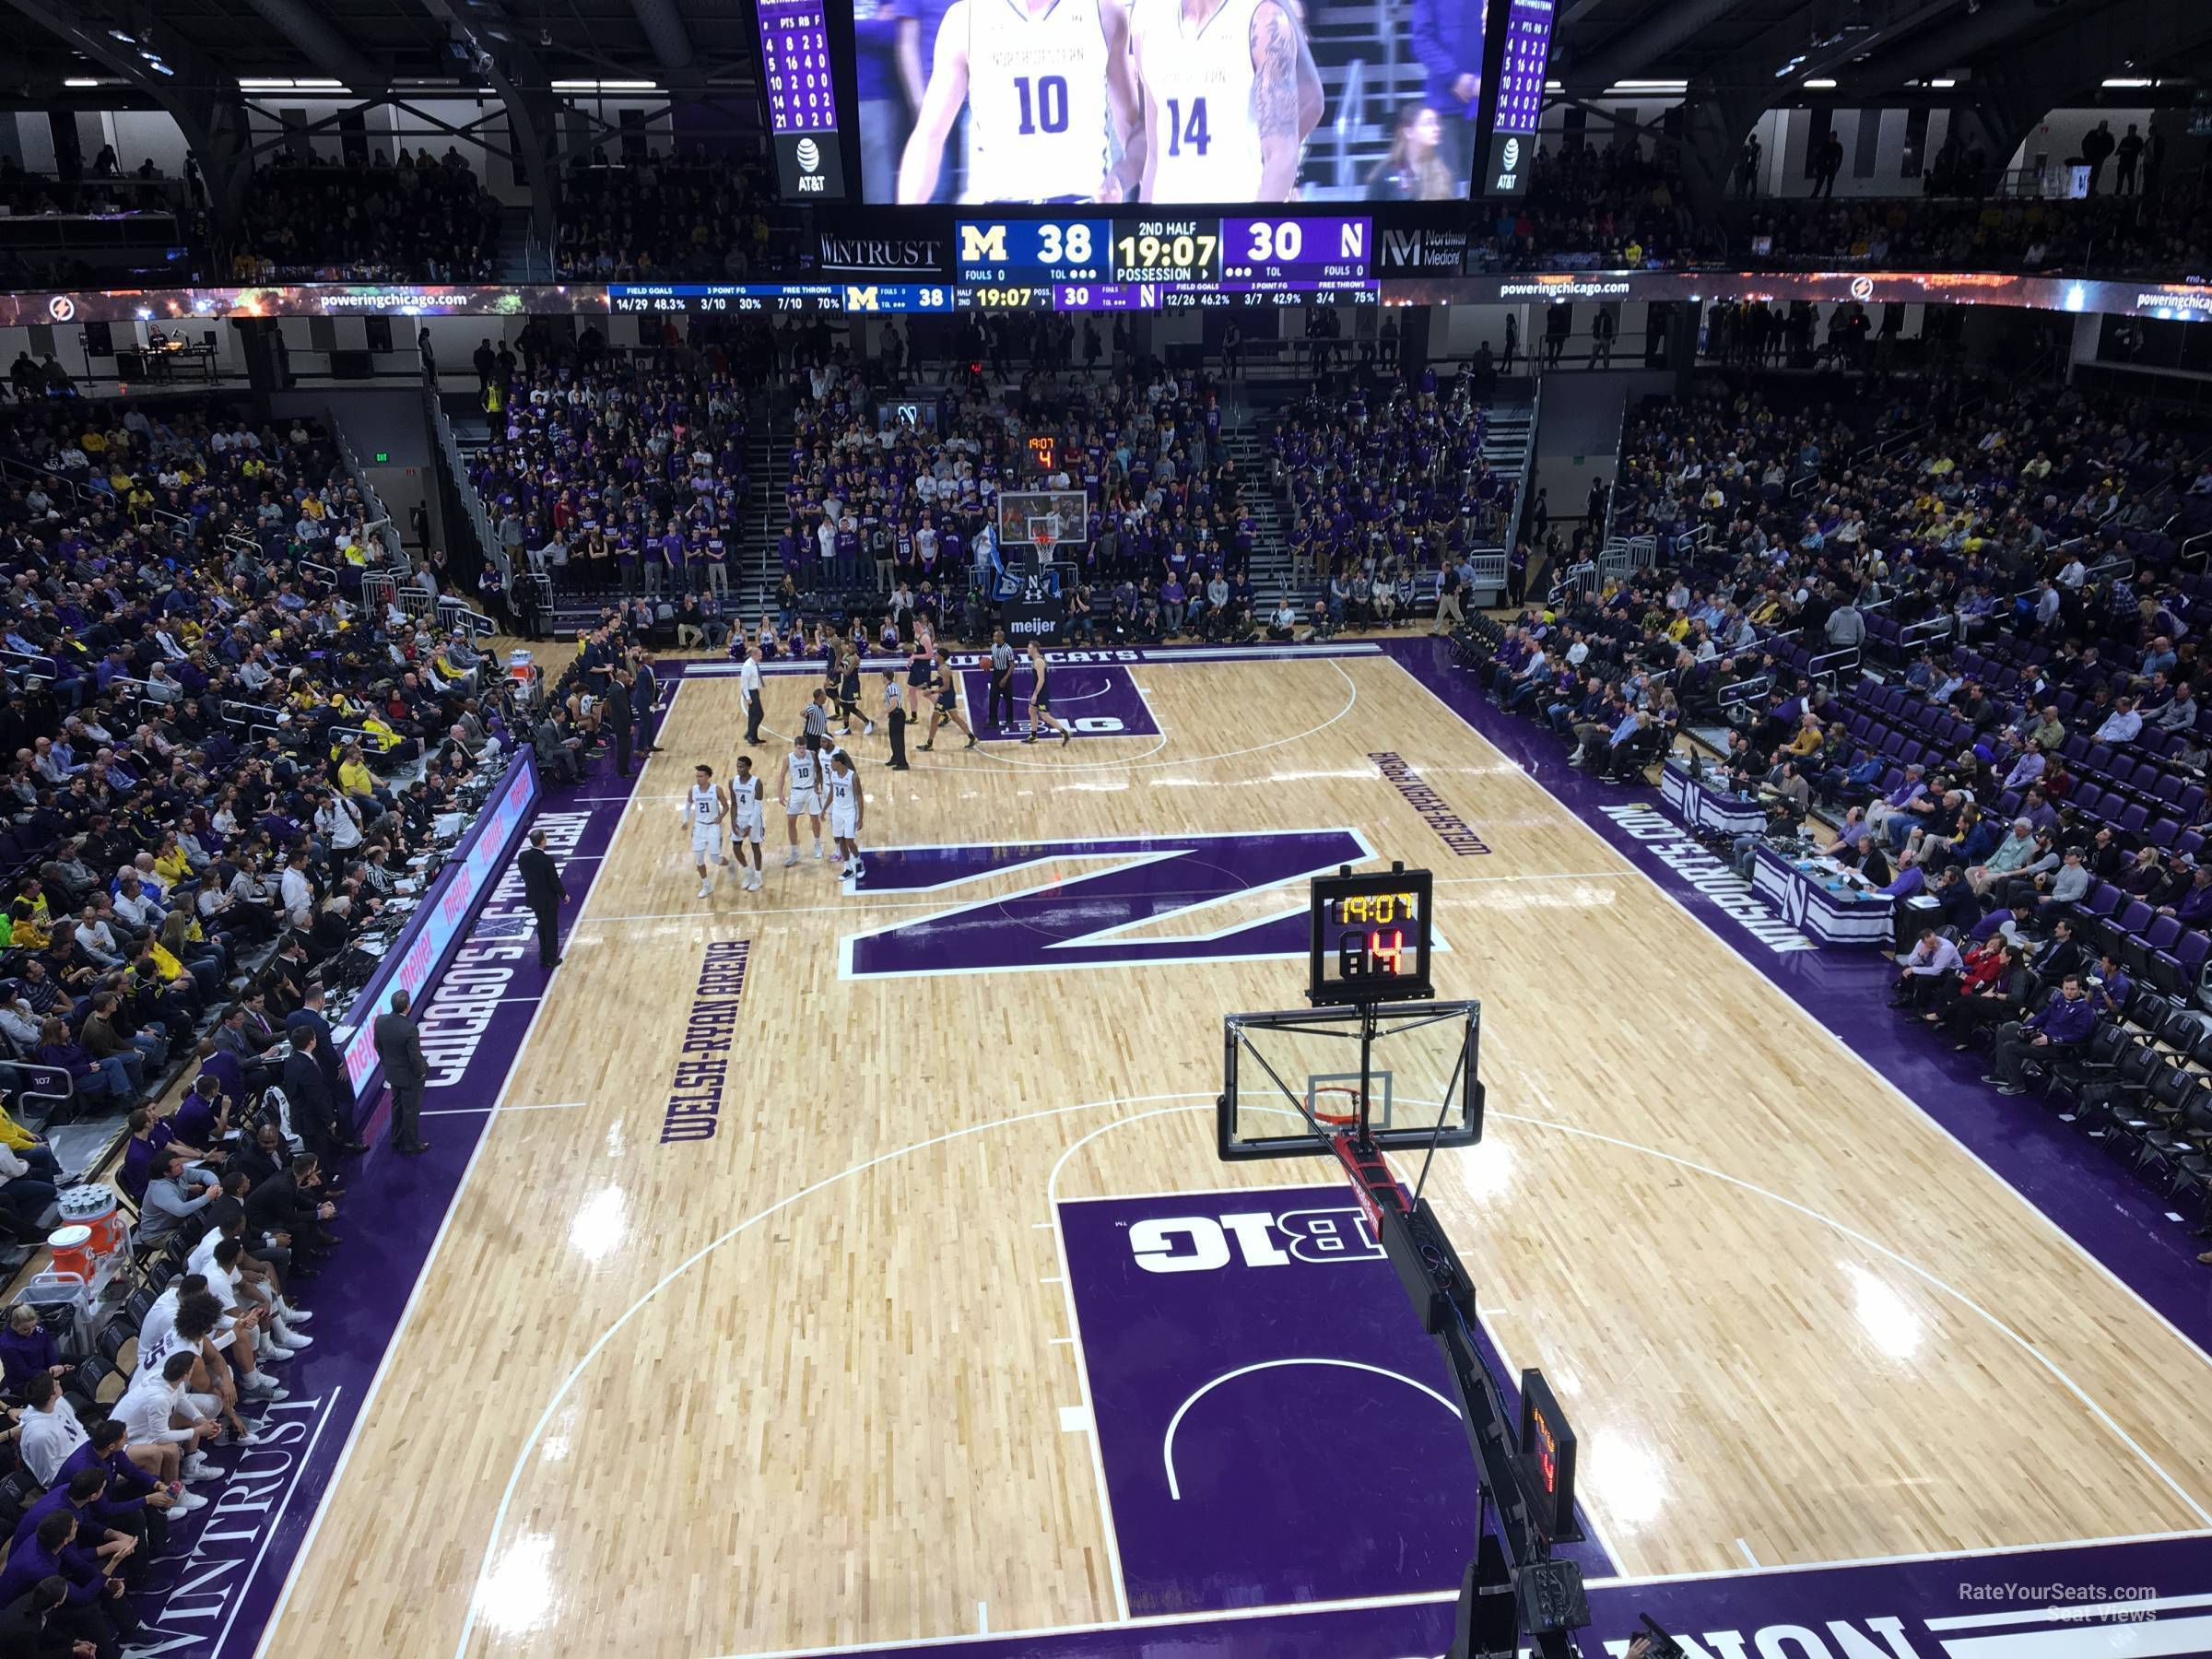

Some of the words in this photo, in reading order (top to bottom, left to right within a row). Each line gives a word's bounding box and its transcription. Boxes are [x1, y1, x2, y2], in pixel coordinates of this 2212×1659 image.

[780, 18, 794, 29] PTS
[798, 16, 809, 27] RB
[815, 15, 819, 26] F
[766, 38, 773, 53] 4
[786, 36, 794, 51] 8
[802, 35, 809, 50] 2
[816, 34, 822, 49] 3
[1508, 38, 1513, 53] 4
[1521, 40, 1527, 54] 8
[1532, 41, 1537, 55] 2
[1540, 42, 1545, 57] 3
[768, 57, 775, 72] 5
[786, 55, 798, 70] 16
[805, 54, 812, 69] 4
[818, 53, 825, 68] 0
[1505, 56, 1511, 71] 5
[1517, 58, 1525, 73] 16
[1529, 60, 1534, 74] 4
[1537, 61, 1543, 75] 0
[771, 76, 782, 90] 10
[791, 75, 798, 89] 2
[806, 74, 814, 88] 0
[821, 73, 828, 88] 0
[1502, 76, 1511, 89] 10
[1515, 76, 1521, 91] 2
[1526, 78, 1532, 92] 0
[1535, 79, 1540, 93] 0
[773, 95, 784, 109] 14
[793, 94, 800, 108] 4
[809, 93, 817, 107] 0
[823, 92, 830, 107] 2
[1014, 76, 1068, 135] 10
[1500, 94, 1508, 108] 14
[1513, 95, 1518, 109] 4
[1524, 96, 1529, 110] 0
[1532, 97, 1537, 111] 2
[775, 113, 786, 128] 21
[795, 112, 803, 127] 0
[811, 112, 818, 126] 2
[826, 112, 832, 125] 0
[1167, 97, 1211, 157] 14
[1497, 112, 1505, 126] 21
[1511, 113, 1516, 127] 0
[1521, 114, 1526, 128] 2
[1530, 114, 1535, 128] 0
[798, 175, 825, 192] AT&T
[1497, 174, 1516, 190] AT&T
[1139, 222, 1162, 236] 2ND
[1167, 222, 1196, 236] HALF
[961, 225, 1006, 261] M
[1037, 224, 1092, 263] 38
[1247, 222, 1301, 261] 30
[1341, 223, 1362, 257] N
[1118, 236, 1216, 266] 19:07
[966, 270, 992, 280] FOULS
[998, 270, 1005, 280] 0
[1051, 270, 1066, 279] TOL
[1117, 268, 1191, 281] POSSESSION
[1266, 267, 1281, 276] TOL
[1324, 265, 1350, 276] FOULS
[1357, 265, 1363, 276] 0
[919, 288, 944, 306] 38
[976, 288, 1030, 306] 19:07
[1065, 288, 1088, 305] 30
[1140, 285, 1154, 307] N
[1316, 291, 1334, 304] 3/4
[1355, 292, 1374, 303] 75%
[1501, 281, 1630, 297] poweringchicago.com
[321, 293, 467, 309] poweringchicago.com
[617, 299, 648, 311] 14/29
[654, 299, 685, 310] 48.3%
[701, 299, 725, 311] 3/10
[740, 299, 761, 310] 30%
[778, 298, 802, 311] 7/10
[818, 299, 839, 309] 70%
[847, 287, 879, 310] M
[1166, 294, 1195, 306] 12/26
[1201, 294, 1230, 305] 46.2%
[1244, 293, 1262, 305] 3/7
[1272, 293, 1301, 304] 42.9%
[1029, 438, 1053, 449] 19:07
[1039, 452, 1051, 467] 4
[899, 544, 910, 553] 18
[1029, 575, 1037, 589] N
[1011, 618, 1056, 635] meijer
[797, 767, 808, 778] 10
[825, 765, 830, 774] 5
[1367, 752, 1423, 782] ARENA
[510, 771, 529, 815] meijer
[740, 794, 746, 804] 4
[835, 787, 845, 798] 14
[700, 802, 710, 813] 21
[1395, 784, 1492, 856] WELSH-RYAN
[480, 813, 504, 865] meijer
[443, 864, 472, 925] meijer
[1782, 873, 1807, 927] N
[1343, 892, 1412, 924] 19:07
[399, 927, 433, 993] meijer
[1372, 930, 1402, 974] 4
[696, 940, 750, 995] ARENA
[660, 1000, 739, 1144] WELSH-RYAN
